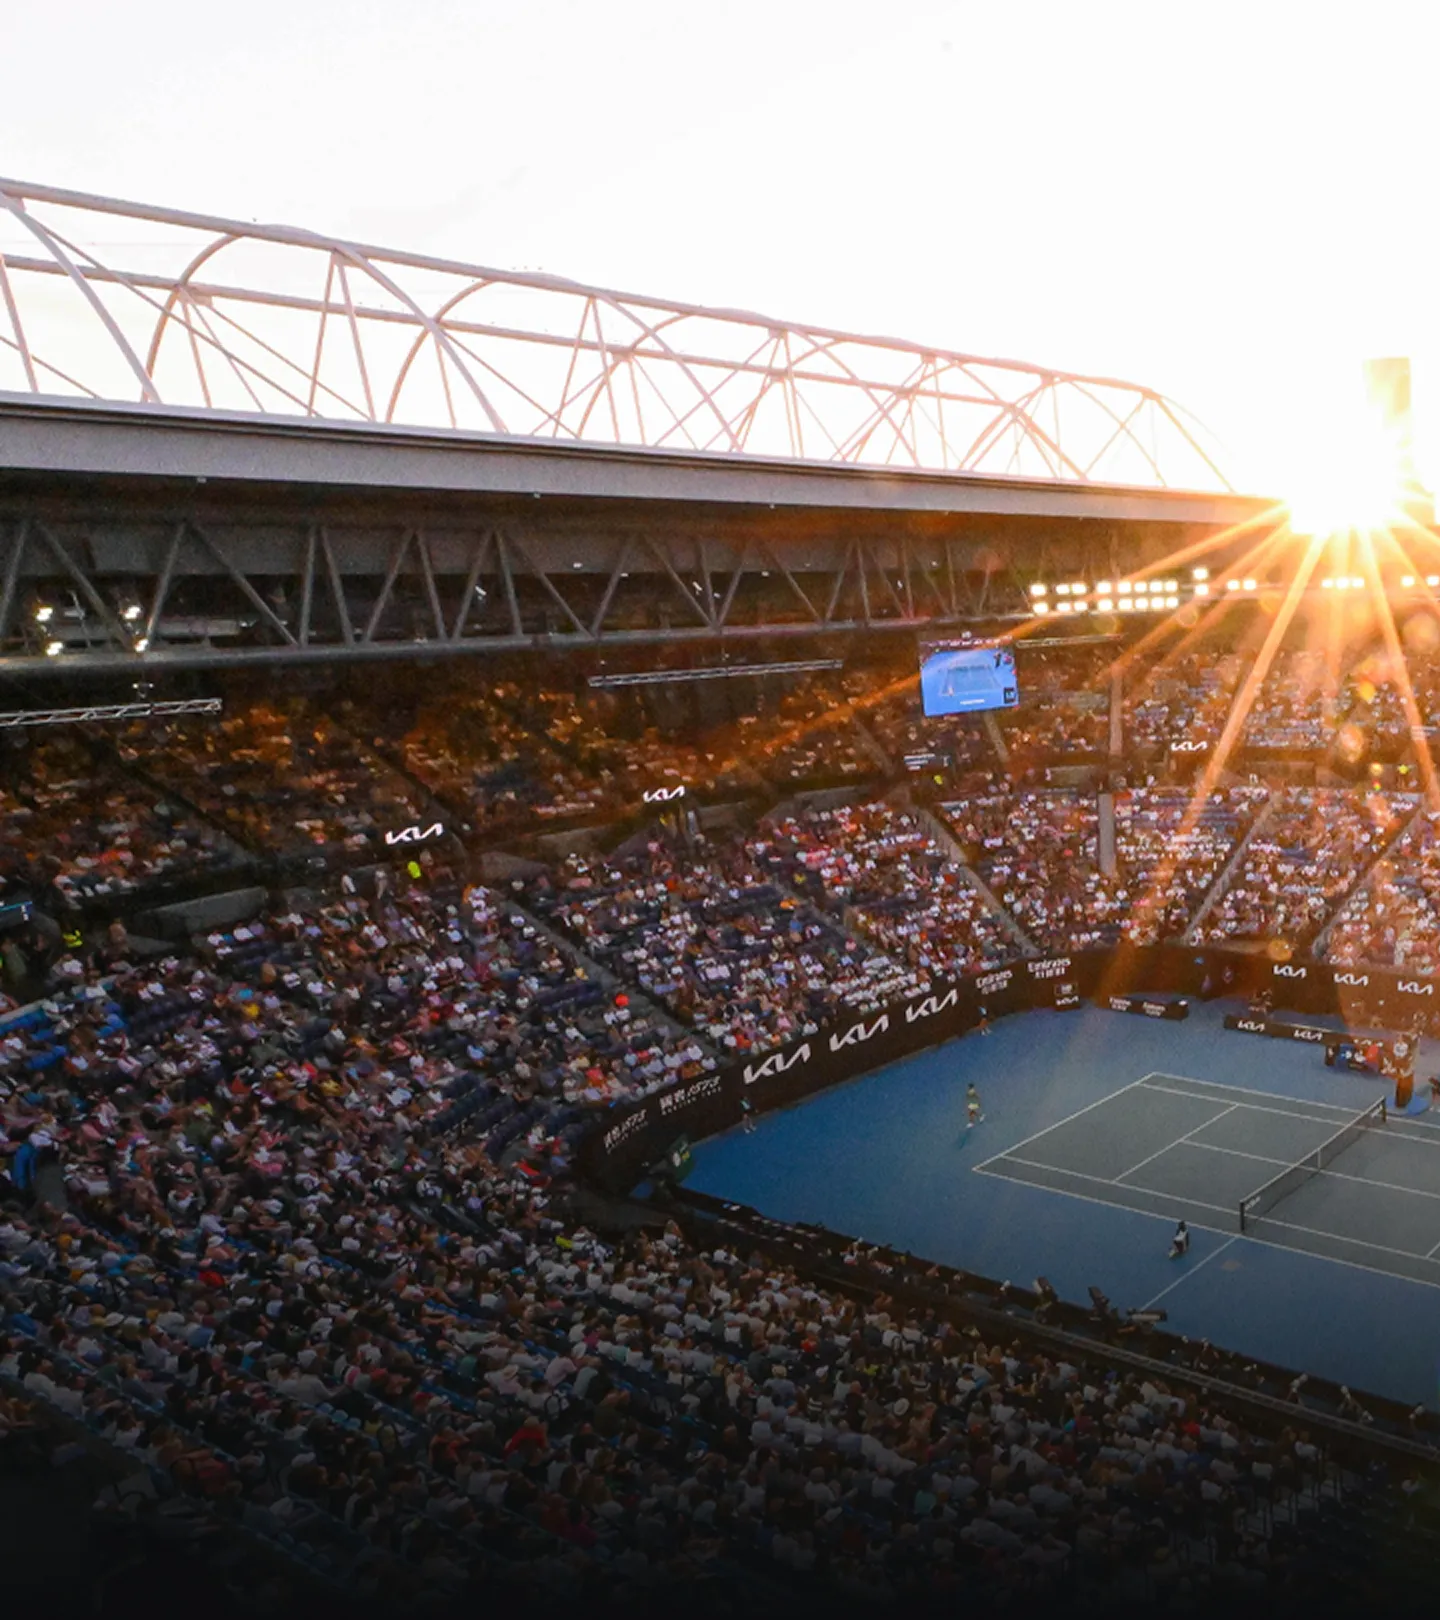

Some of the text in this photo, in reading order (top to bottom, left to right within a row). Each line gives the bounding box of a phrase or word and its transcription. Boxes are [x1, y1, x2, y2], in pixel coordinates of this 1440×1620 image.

[642, 785, 686, 803] KIA
[385, 822, 444, 845] KIA
[1273, 964, 1307, 978] KIA
[1333, 973, 1369, 986] KIA
[1397, 980, 1434, 995] KIA
[904, 988, 959, 1023] KIA
[829, 1014, 889, 1053] KIA
[743, 1044, 811, 1084] KIA
